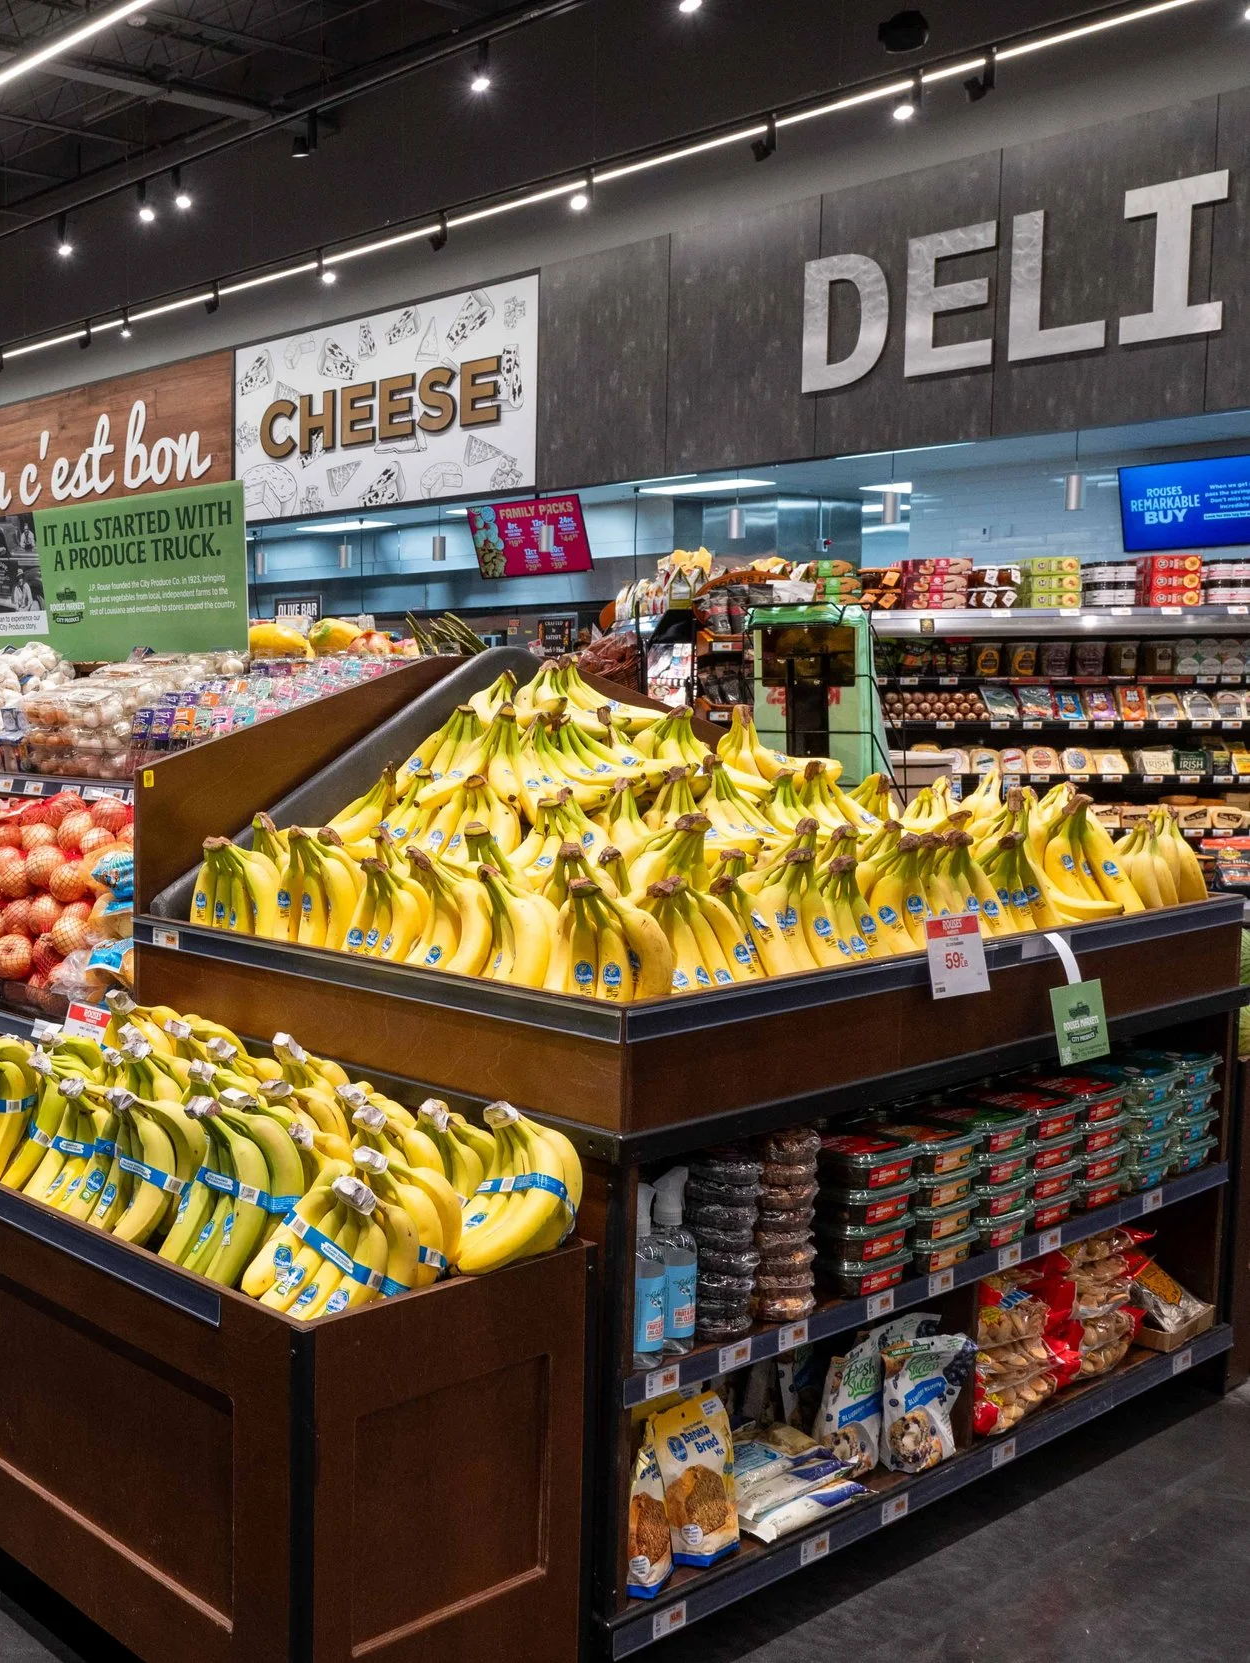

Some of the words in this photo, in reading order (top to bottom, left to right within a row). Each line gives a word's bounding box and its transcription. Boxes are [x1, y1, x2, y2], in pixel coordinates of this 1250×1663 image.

[802, 169, 1229, 393] DELI
[260, 355, 502, 459] CHEESE
[19, 413, 114, 507] c'est
[124, 400, 212, 490] bon
[1146, 486, 1182, 497] ROUSES
[1230, 488, 1250, 496] saving
[1237, 481, 1248, 489] get
[499, 505, 536, 520] FAMILY
[538, 501, 574, 516] PACKS
[1131, 494, 1200, 512] REMARKABLE
[1219, 502, 1249, 510] incredible
[43, 524, 57, 547] IT
[62, 520, 90, 545] ALL
[94, 509, 170, 541] STARTED
[175, 500, 232, 530] WITH
[1144, 508, 1188, 525] BUY
[54, 550, 66, 571] A
[69, 540, 146, 570] PRODUCE
[151, 532, 222, 562] TRUCK.
[111, 581, 130, 590] founded
[131, 580, 139, 588] the
[140, 579, 150, 590] City
[150, 577, 171, 587] Produce
[172, 577, 181, 585] Co.
[182, 576, 187, 584] in
[202, 574, 226, 585] bringing
[100, 594, 110, 602] and
[110, 594, 135, 603] vegetables
[135, 593, 149, 601] from
[149, 592, 161, 601] local,
[162, 589, 194, 600] independent
[195, 588, 211, 597] farms
[211, 588, 218, 596] to
[218, 587, 228, 595] the
[99, 607, 104, 615] of
[104, 606, 126, 615] Louisiana
[126, 605, 135, 614] and
[136, 604, 161, 614] eventually
[168, 603, 184, 611] stores
[184, 602, 203, 610] around
[204, 601, 213, 609] the
[214, 600, 237, 610] country.
[278, 603, 300, 616] OLIVE
[301, 602, 317, 616] BAR
[0, 623, 7, 631] City
[25, 622, 37, 631] story.
[11, 615, 33, 623] experience
[1179, 760, 1204, 771] IRISH
[843, 1356, 876, 1386] Fresh
[848, 1373, 881, 1396] Succes
[680, 1424, 710, 1444] Banana
[694, 1434, 720, 1454] Bread
[714, 1447, 725, 1458] Mix
